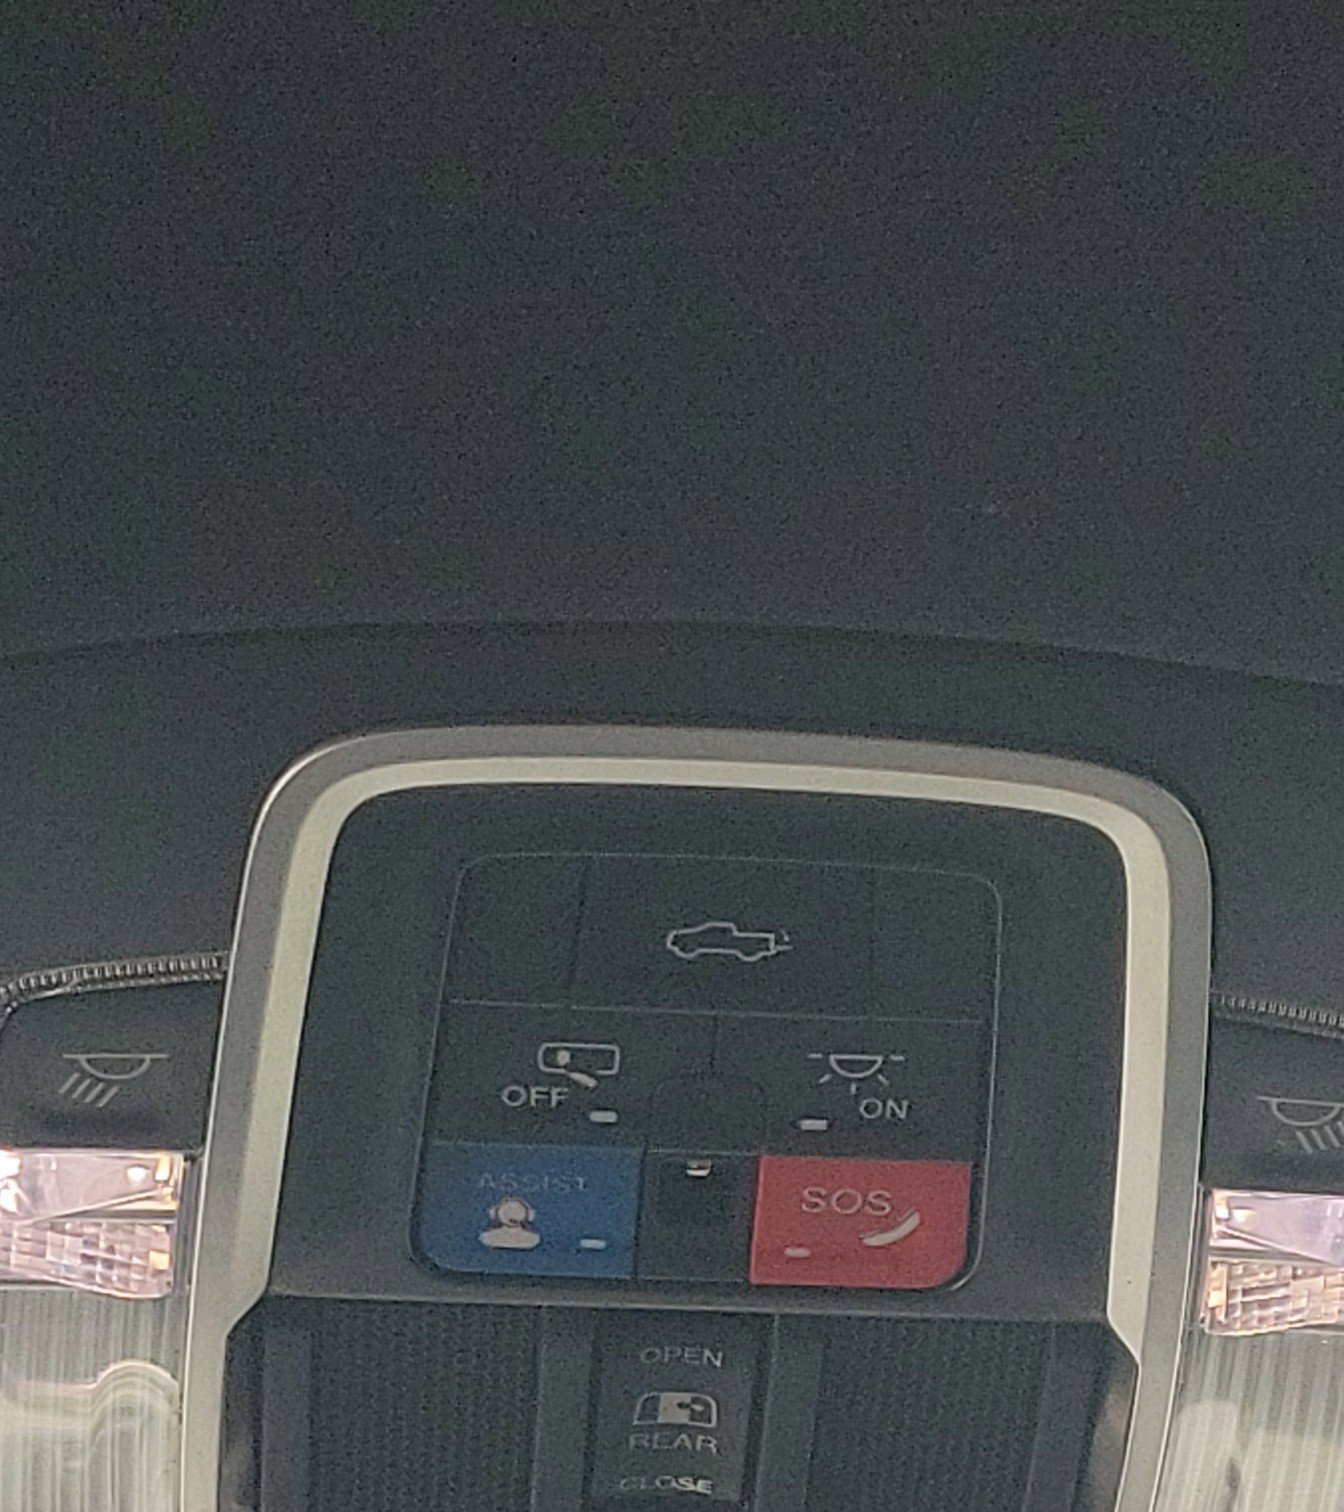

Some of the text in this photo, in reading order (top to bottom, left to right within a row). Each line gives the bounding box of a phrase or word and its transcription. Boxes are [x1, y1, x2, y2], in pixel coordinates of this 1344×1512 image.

[500, 1086, 569, 1109] OFF
[859, 1099, 909, 1121] ON
[478, 1171, 588, 1193] ASSIST
[801, 1187, 894, 1217] SOS
[639, 1346, 724, 1369] OPEN
[628, 1432, 719, 1455] REAR
[618, 1475, 714, 1495] CLOSE
